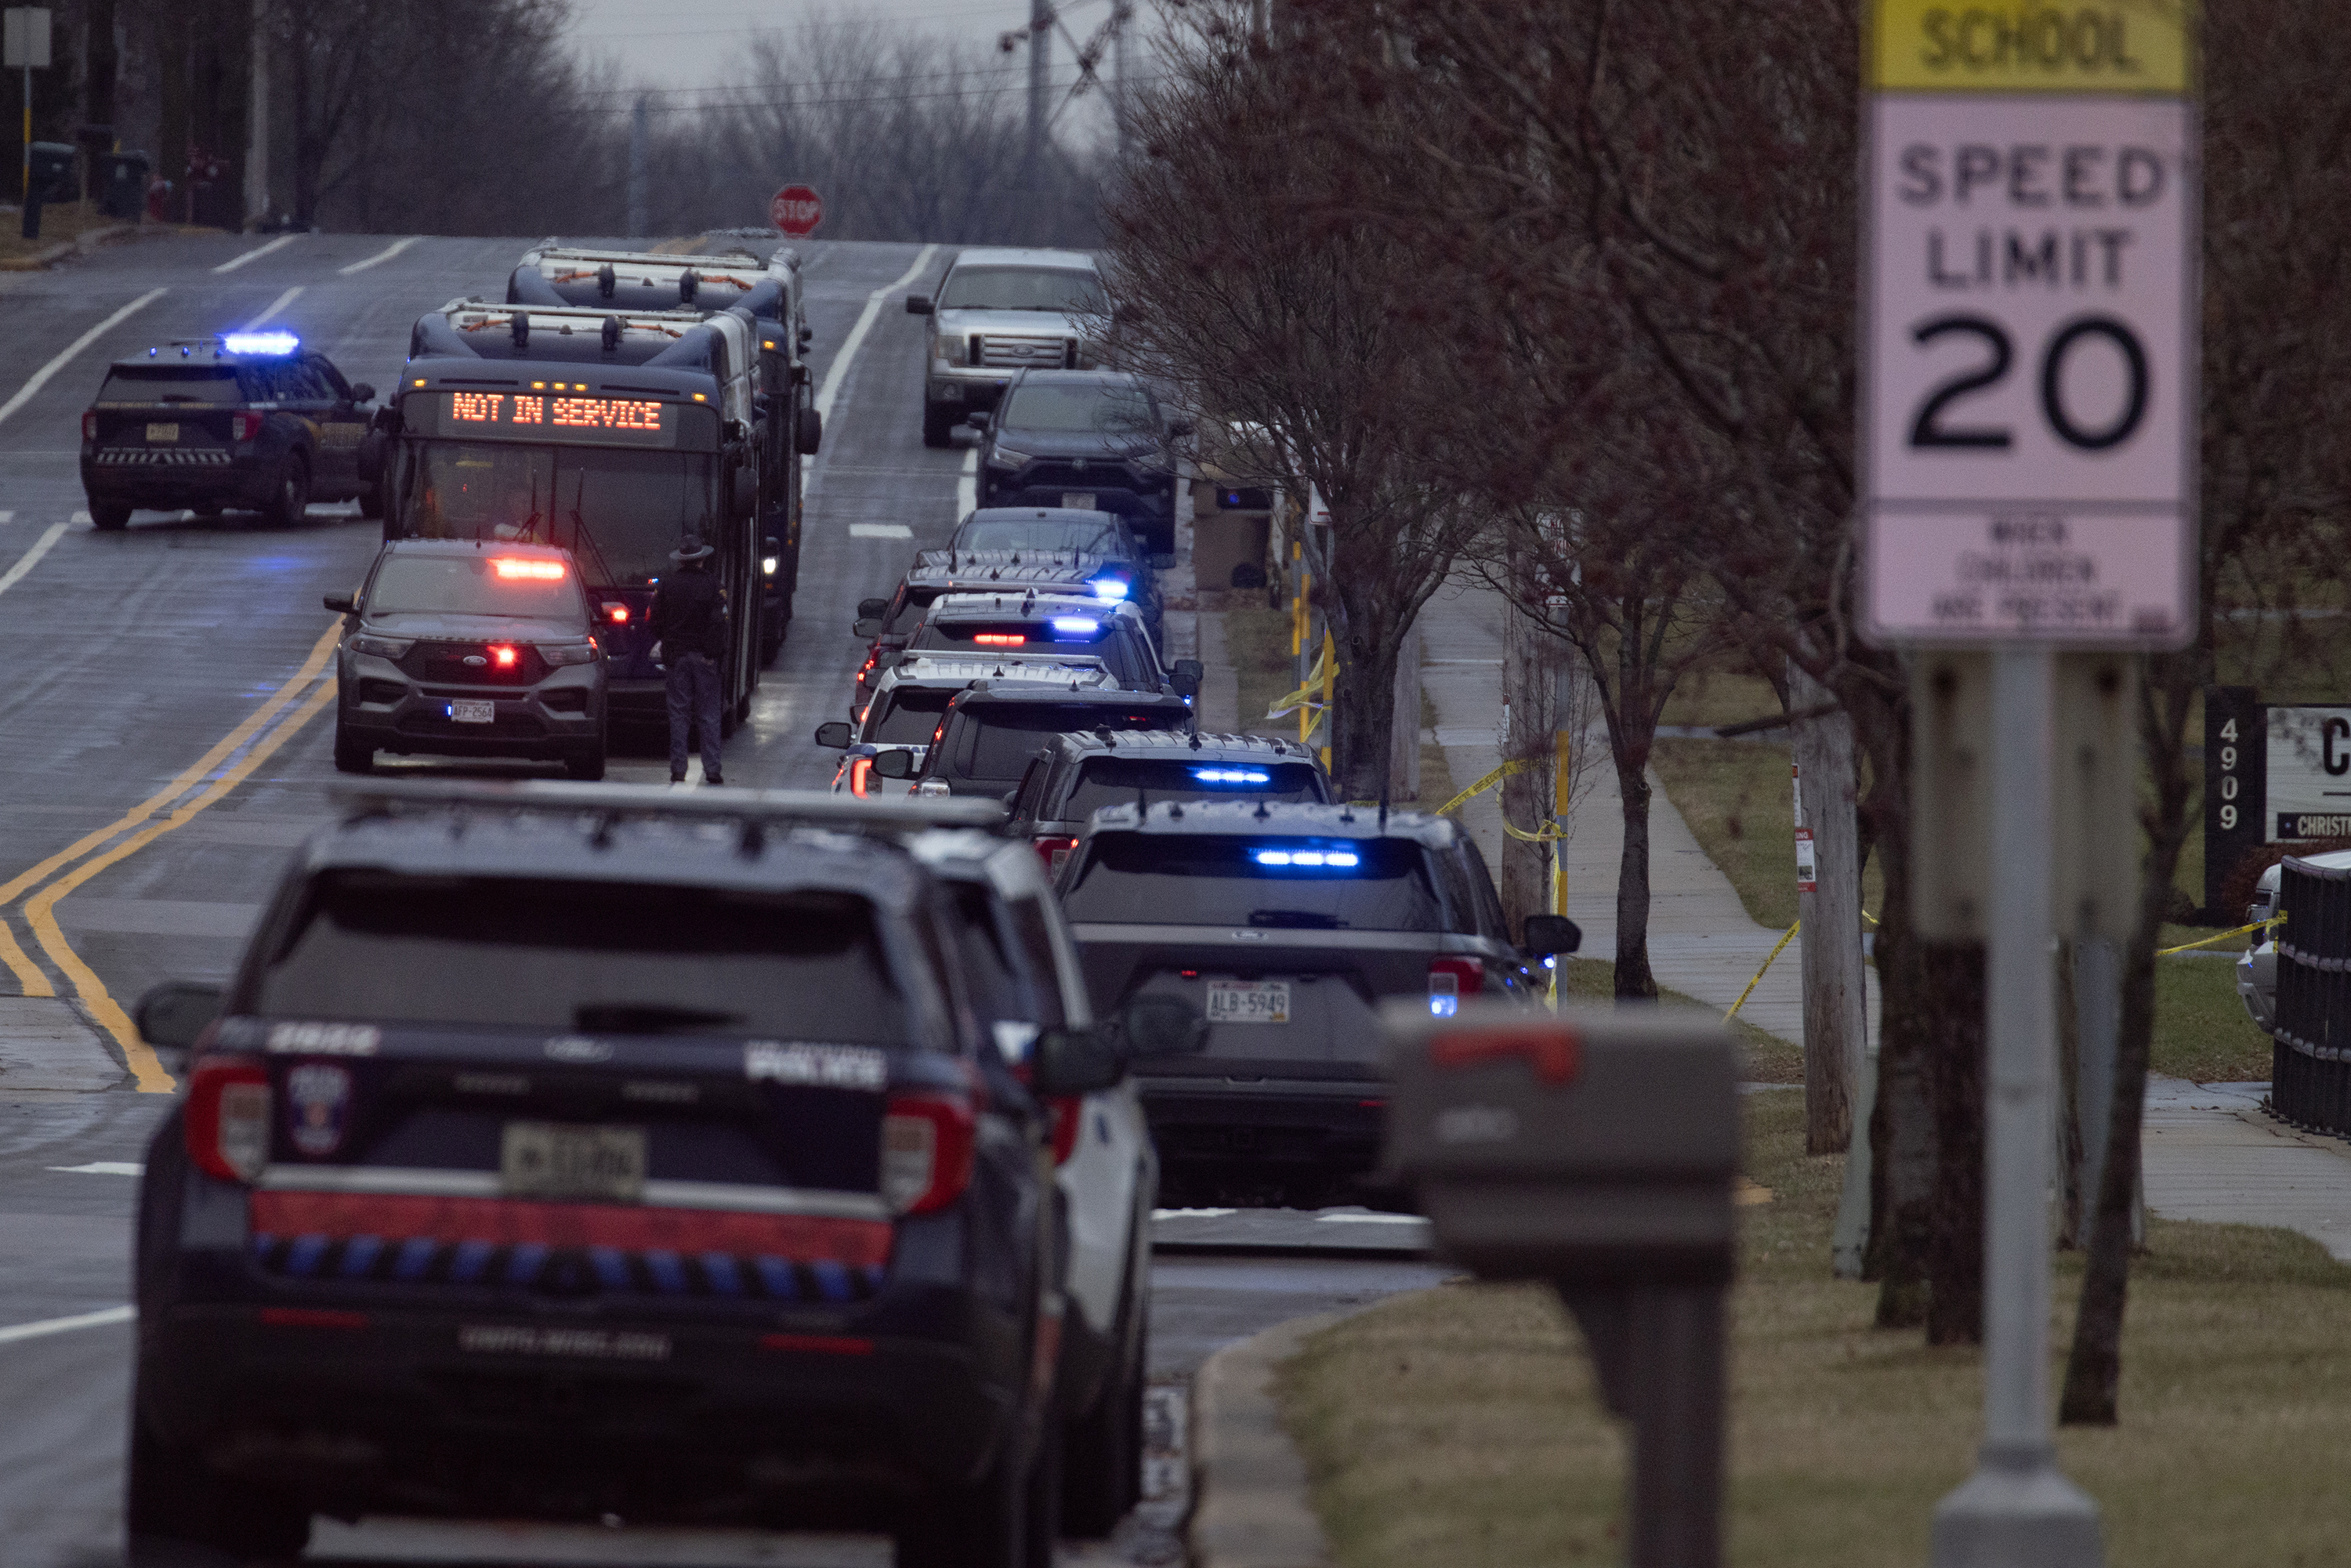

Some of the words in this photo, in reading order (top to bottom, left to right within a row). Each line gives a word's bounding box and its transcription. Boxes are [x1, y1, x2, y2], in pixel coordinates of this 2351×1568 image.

[1919, 7, 2138, 74] SCHOOL
[1898, 144, 2168, 208] SPEED
[774, 198, 820, 220] STOP
[1926, 227, 2132, 288] LIMIT
[453, 393, 504, 422] NOT
[513, 396, 543, 424] IN
[552, 397, 661, 430] SERVICE
[1907, 313, 2150, 451] 20
[2219, 718, 2239, 830] 4909
[1211, 991, 1286, 1012] ALB-5949
